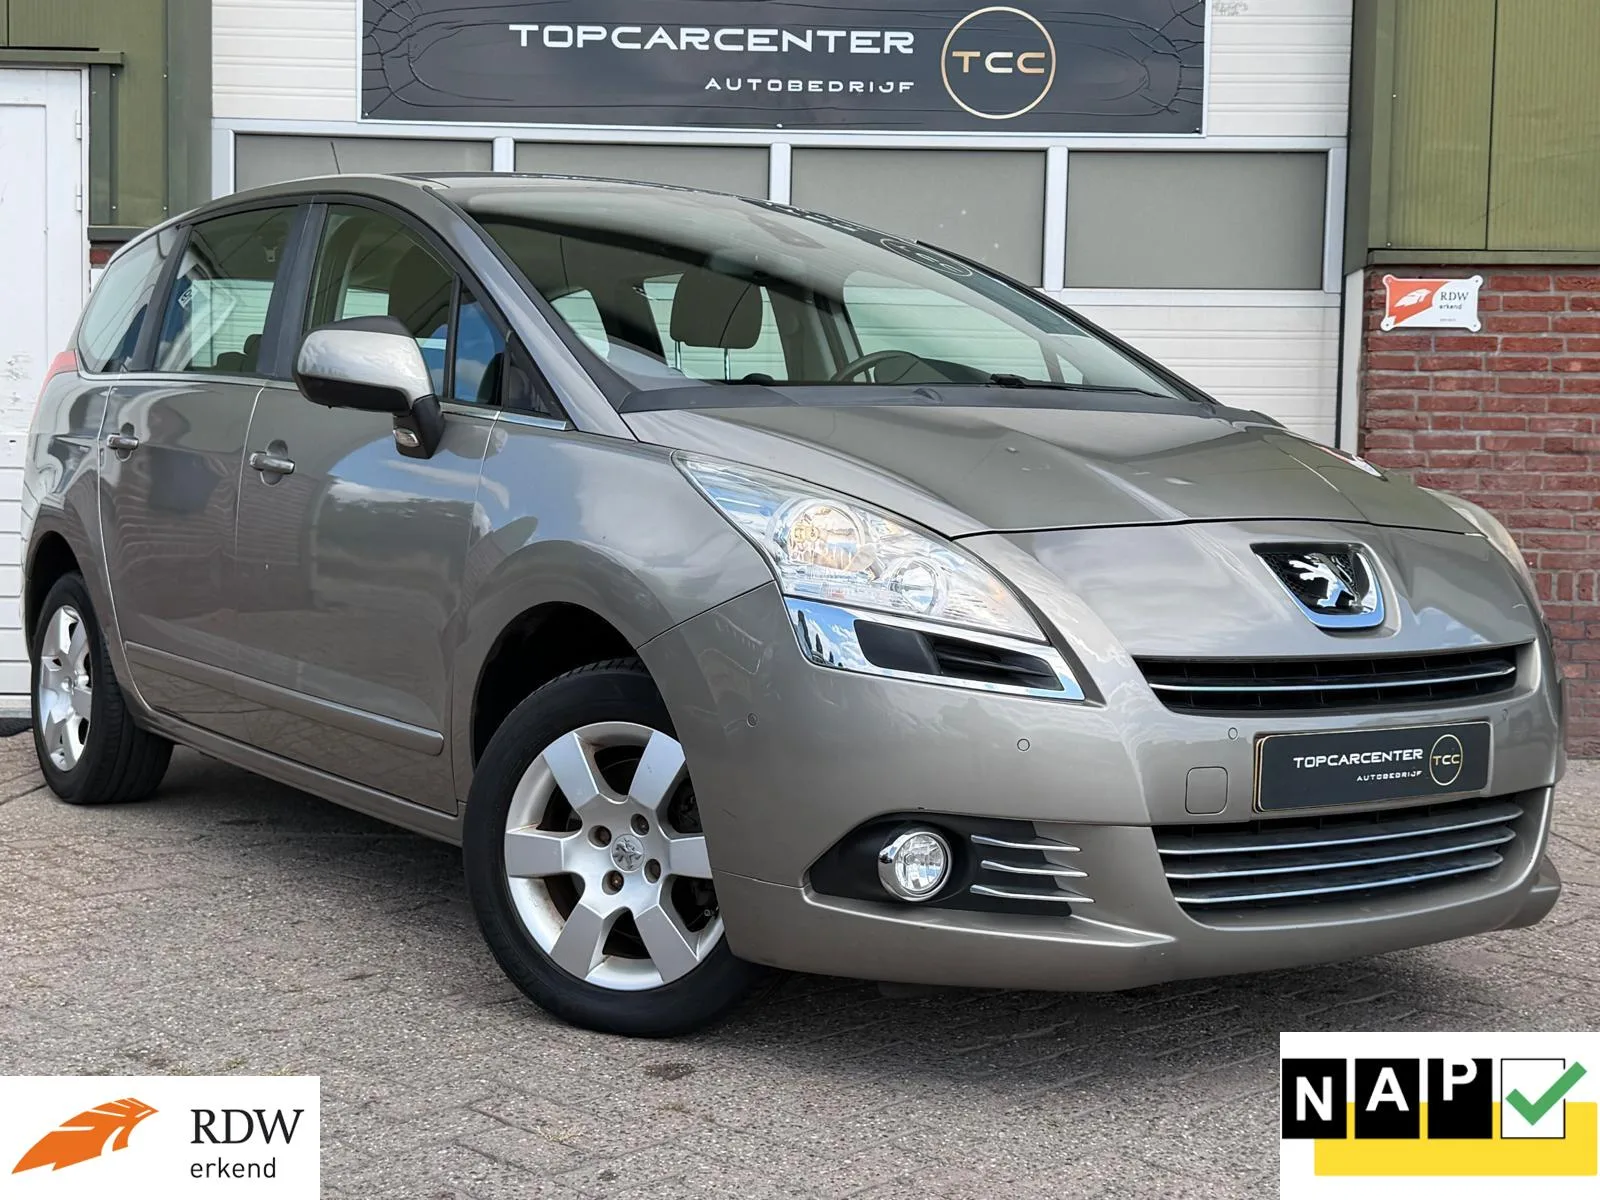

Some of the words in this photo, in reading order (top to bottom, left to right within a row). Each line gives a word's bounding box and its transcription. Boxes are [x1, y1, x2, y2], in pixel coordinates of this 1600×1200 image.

[508, 24, 915, 54] TOPCARCENTER
[951, 50, 1046, 74] TCC
[704, 77, 915, 93] AUTOBEDRIJF
[1440, 291, 1469, 301] RDW
[1293, 748, 1424, 769] TOPCARCENTER
[1432, 753, 1461, 767] TCC
[1356, 770, 1423, 782] AUTOBEDRIJF
